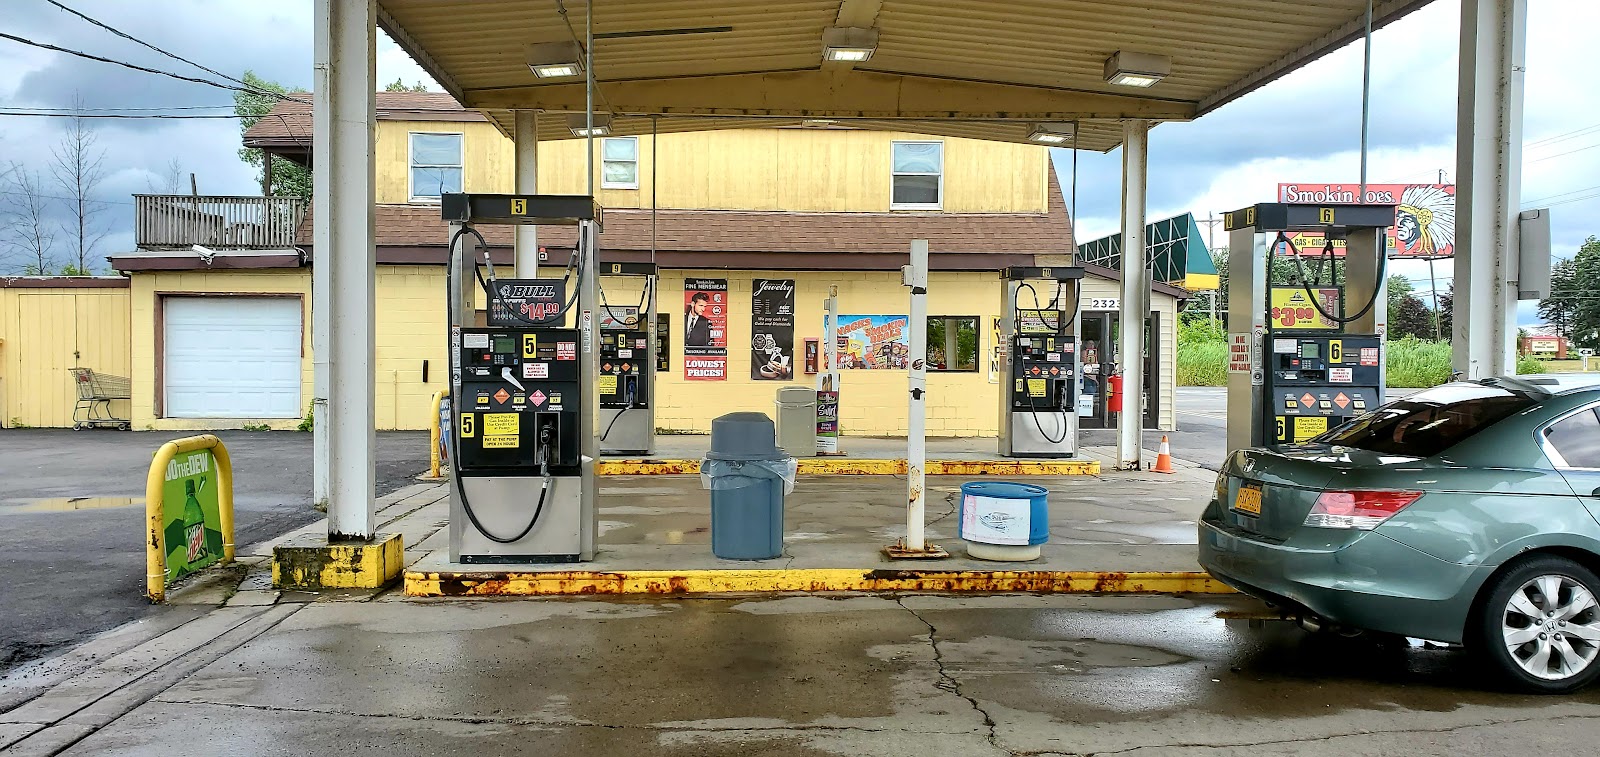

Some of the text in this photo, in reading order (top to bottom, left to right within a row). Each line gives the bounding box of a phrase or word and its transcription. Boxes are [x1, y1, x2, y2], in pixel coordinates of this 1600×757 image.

[1287, 184, 1354, 203] Smokin
[514, 200, 523, 214] 5
[1324, 209, 1330, 221] 6
[1294, 238, 1347, 246] GAS CIGATTES
[614, 264, 619, 272] 9
[1043, 268, 1051, 277] 10
[510, 285, 556, 298] BULL
[753, 280, 794, 299] Jewelry
[520, 302, 560, 321] $14.99
[864, 318, 907, 338] SMOKIN
[619, 336, 625, 346] 9
[870, 328, 902, 344] DEALS
[525, 337, 535, 355] 5
[557, 343, 565, 351] DO
[565, 343, 576, 351] NOT
[1331, 343, 1340, 360] 6
[685, 360, 726, 368] LOWEST
[687, 369, 724, 377] PRICES!
[817, 404, 837, 416] Swirl
[462, 416, 473, 434] 5
[1276, 419, 1284, 437] 6
[187, 452, 209, 476] DEW
